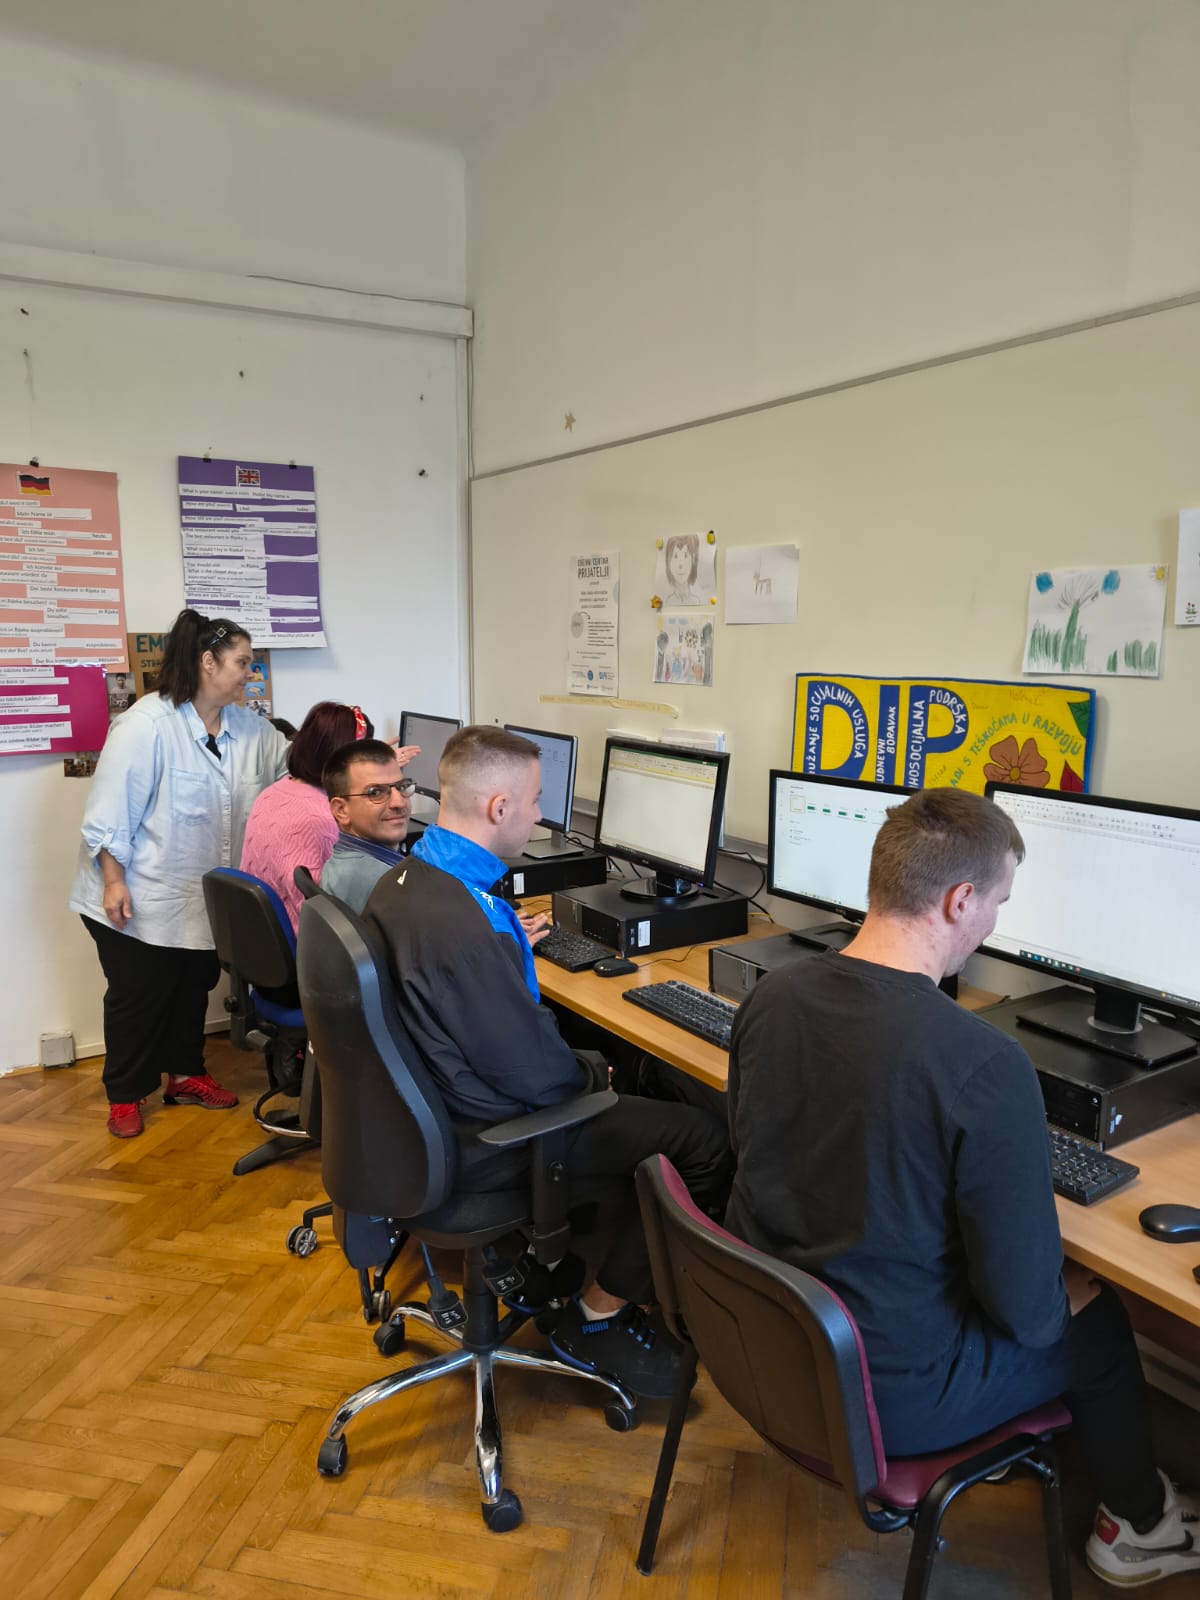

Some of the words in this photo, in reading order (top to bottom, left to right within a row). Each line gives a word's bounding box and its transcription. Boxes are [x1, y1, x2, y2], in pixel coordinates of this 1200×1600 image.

[577, 566, 609, 579] PRIJATELJI
[810, 685, 855, 721] SOCIJALNIH
[852, 709, 866, 758] USLUGA
[886, 706, 896, 754] BORAVAK
[929, 689, 967, 735] PODRSKA
[876, 738, 886, 784] UDNEVNI
[949, 768, 965, 788] ADI
[964, 757, 972, 766] S
[1022, 713, 1031, 724] U
[1033, 715, 1082, 756] RAZVOJU
